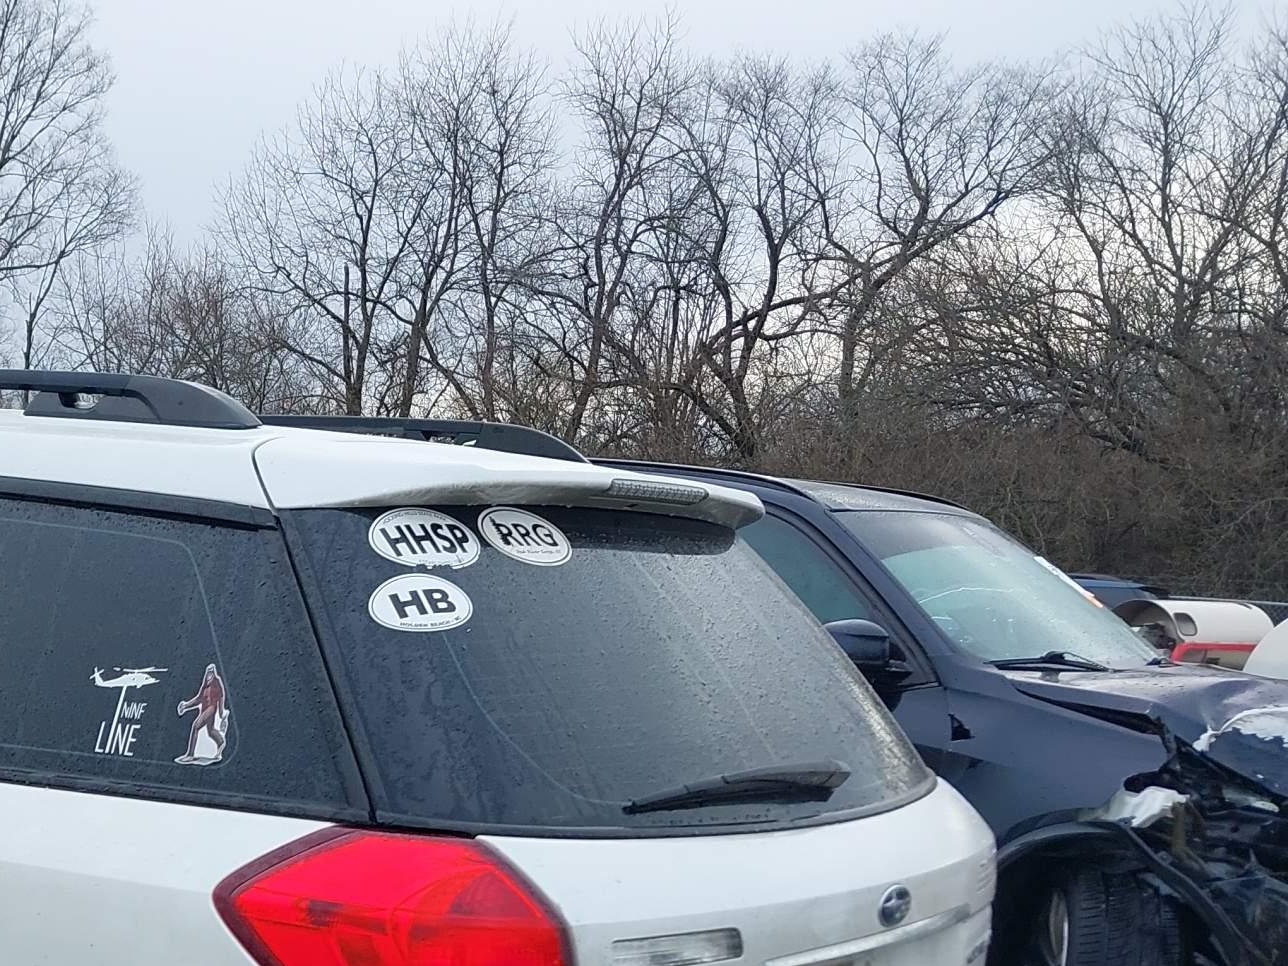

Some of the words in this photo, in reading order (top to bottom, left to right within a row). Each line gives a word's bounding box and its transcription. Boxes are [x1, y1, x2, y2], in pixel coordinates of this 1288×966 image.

[378, 522, 470, 557] HHSP
[489, 515, 559, 547] RRG
[388, 588, 456, 619] HB
[94, 720, 142, 757] LINE
